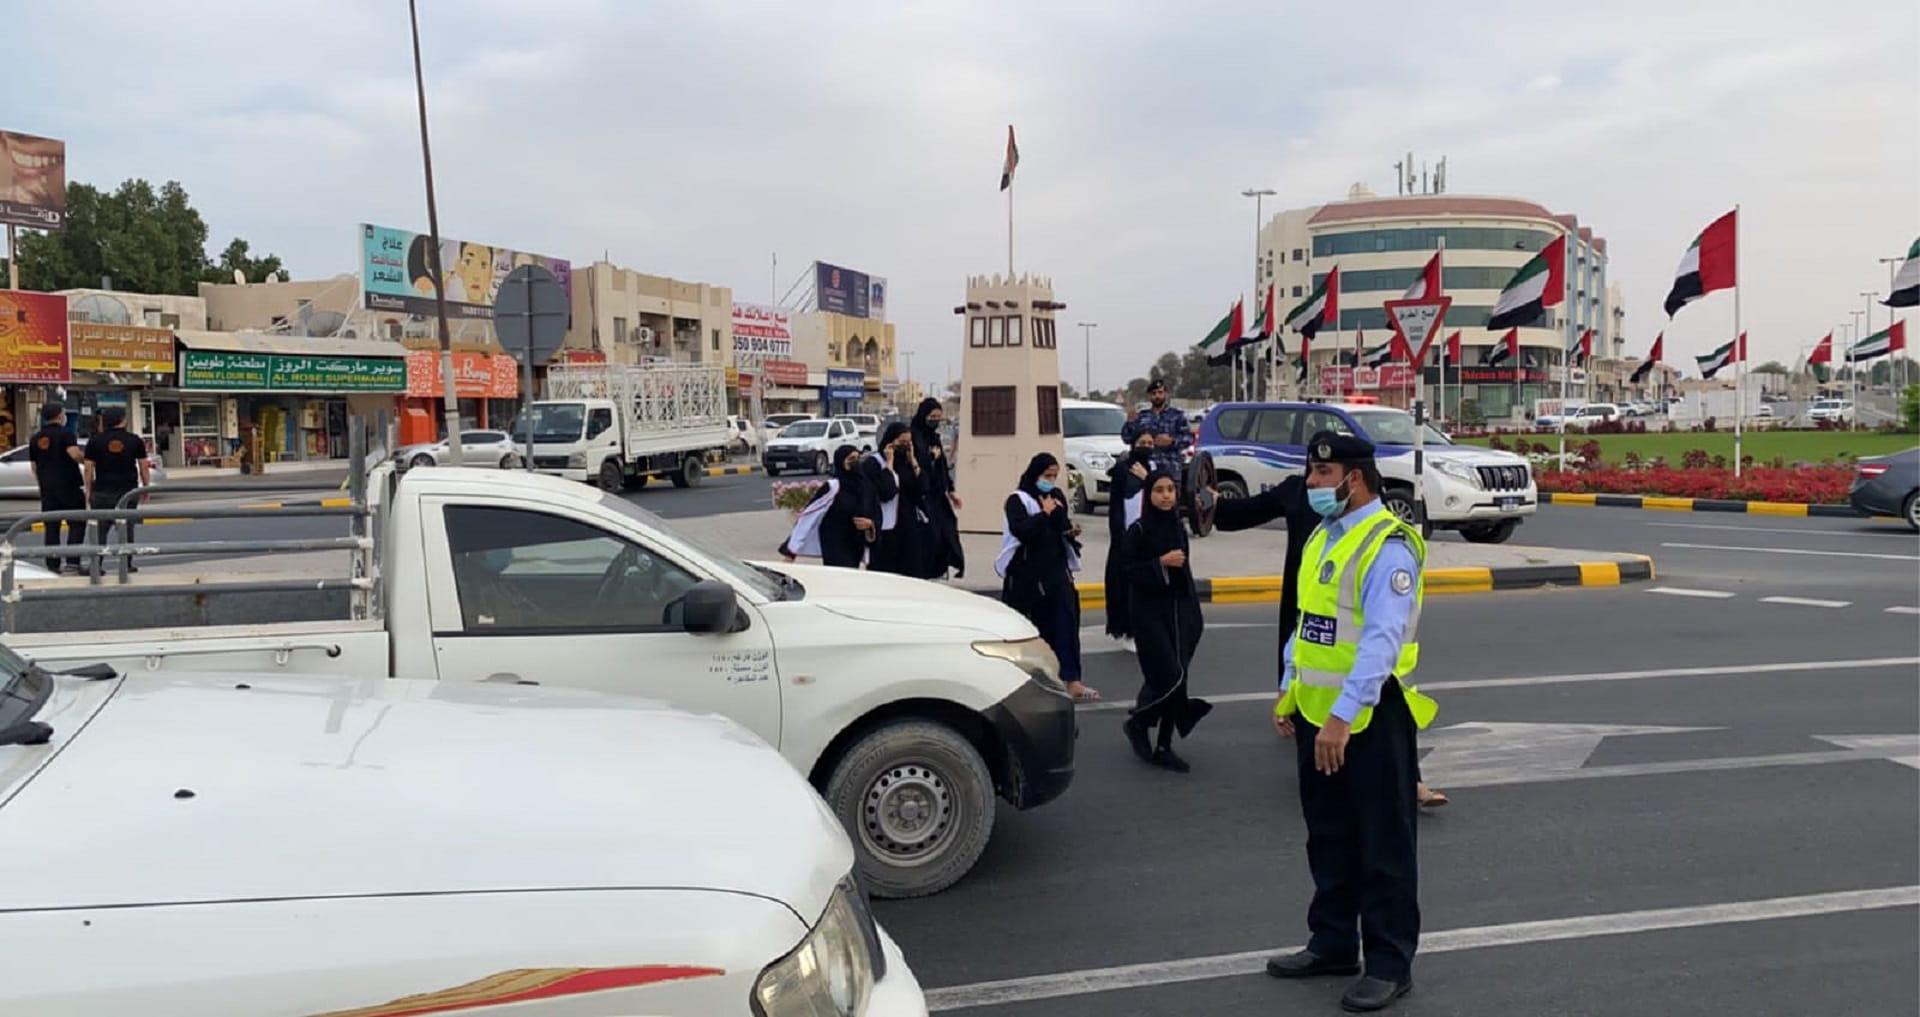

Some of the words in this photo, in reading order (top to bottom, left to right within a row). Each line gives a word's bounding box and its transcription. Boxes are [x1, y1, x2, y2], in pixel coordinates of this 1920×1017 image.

[382, 236, 403, 251] علاج
[372, 267, 403, 284] الشعر
[273, 358, 312, 373] الروز
[291, 373, 323, 382] ROSE
[325, 373, 402, 383] SUPERMARKET
